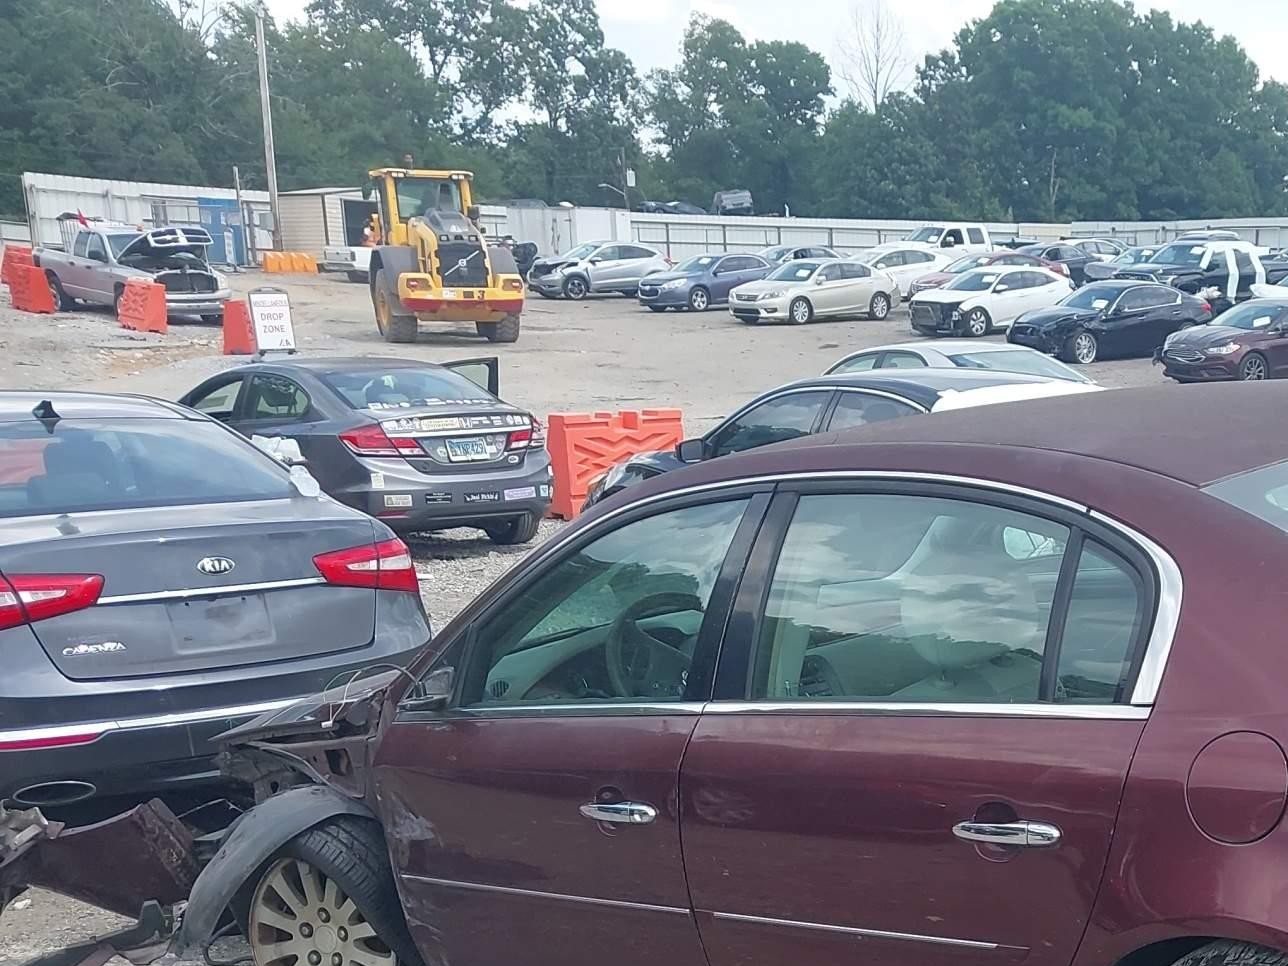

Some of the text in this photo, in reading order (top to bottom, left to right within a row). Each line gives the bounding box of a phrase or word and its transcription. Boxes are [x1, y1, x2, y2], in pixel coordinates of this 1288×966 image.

[260, 312, 284, 321] DROP
[263, 324, 286, 333] ZONE
[202, 557, 232, 573] KIA
[63, 642, 126, 656] CADENZA
